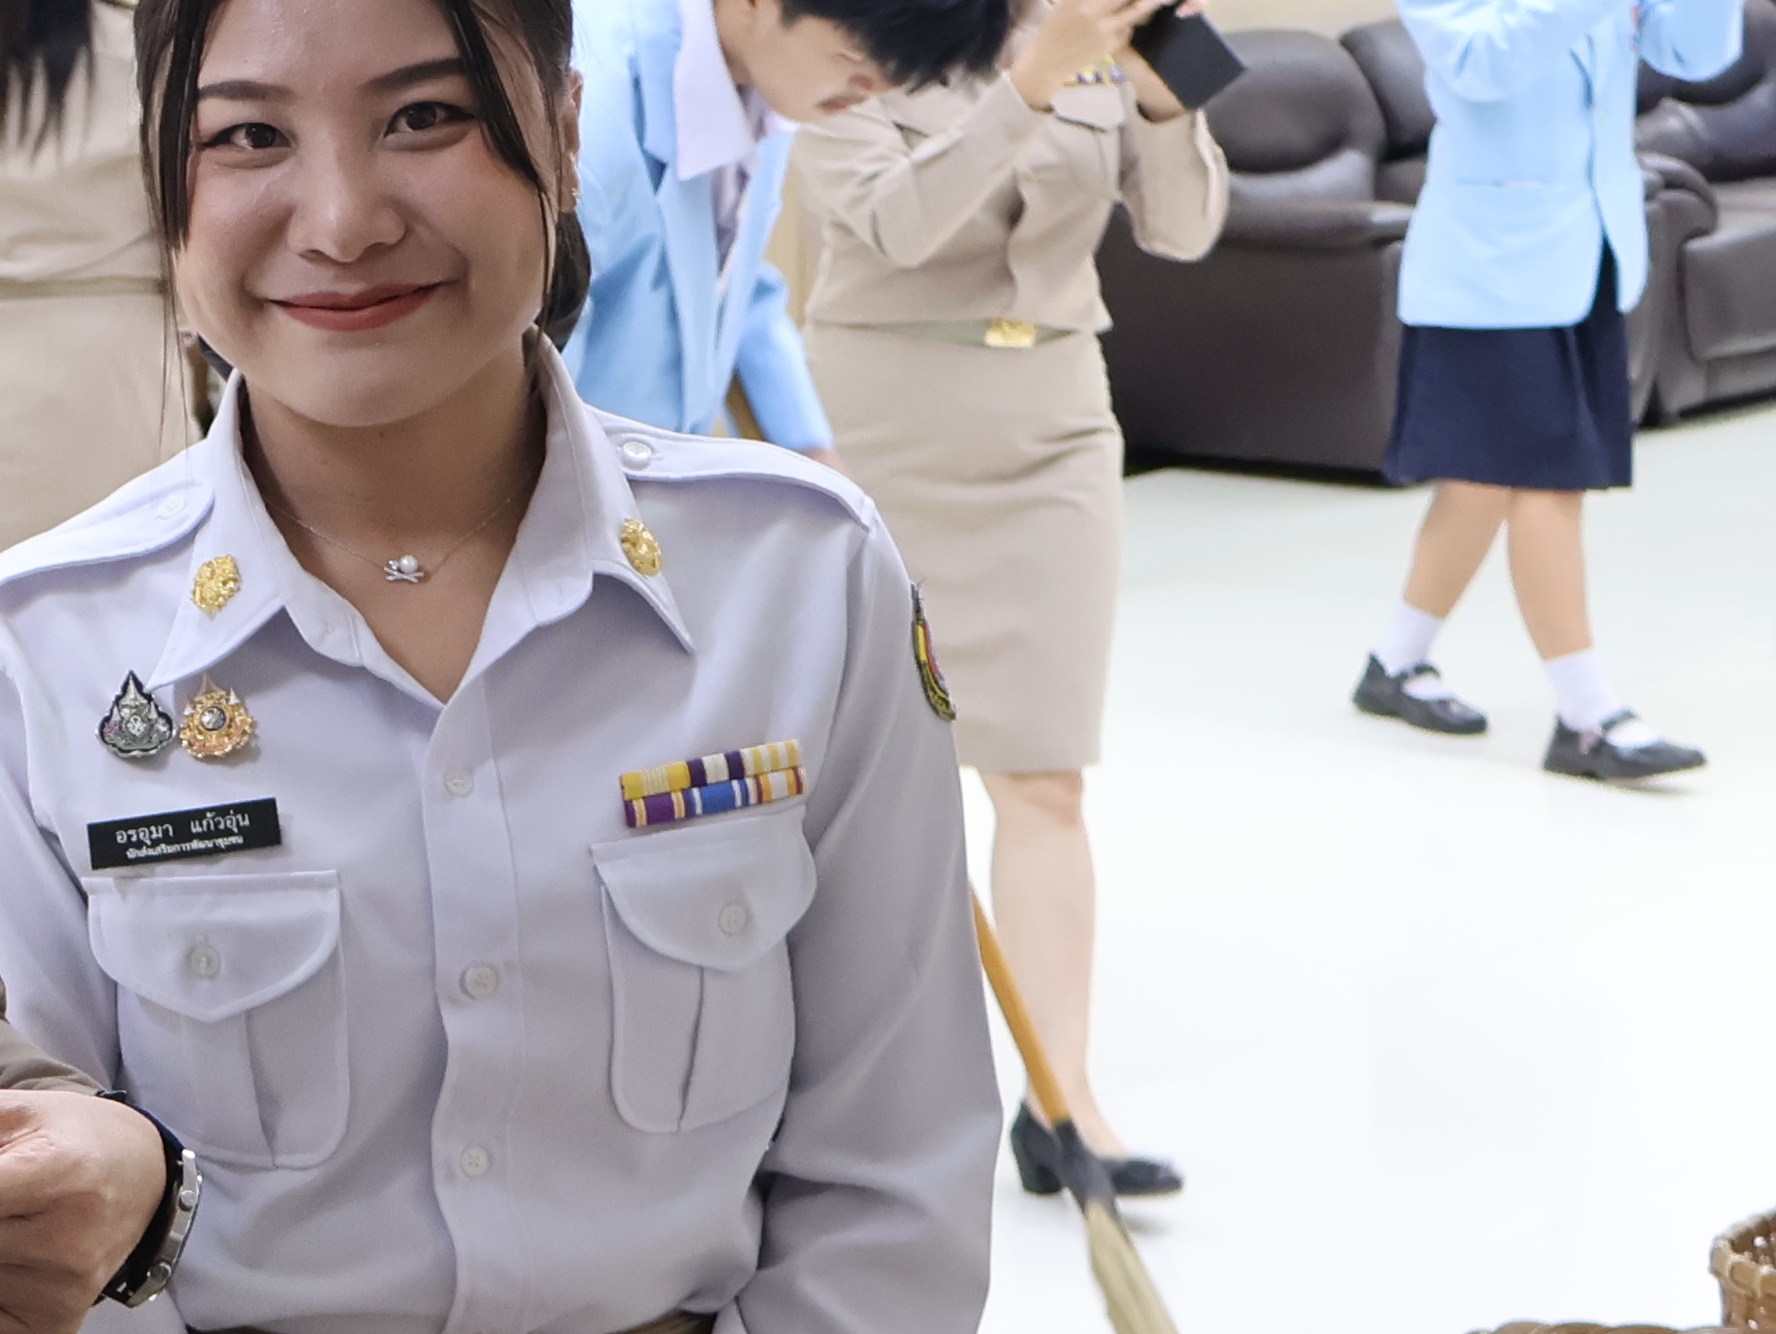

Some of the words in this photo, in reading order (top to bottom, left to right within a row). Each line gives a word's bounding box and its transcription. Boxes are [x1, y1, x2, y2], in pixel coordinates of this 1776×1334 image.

[115, 823, 173, 846] อรอุมา
[190, 809, 250, 834] แก้วอุ่น
